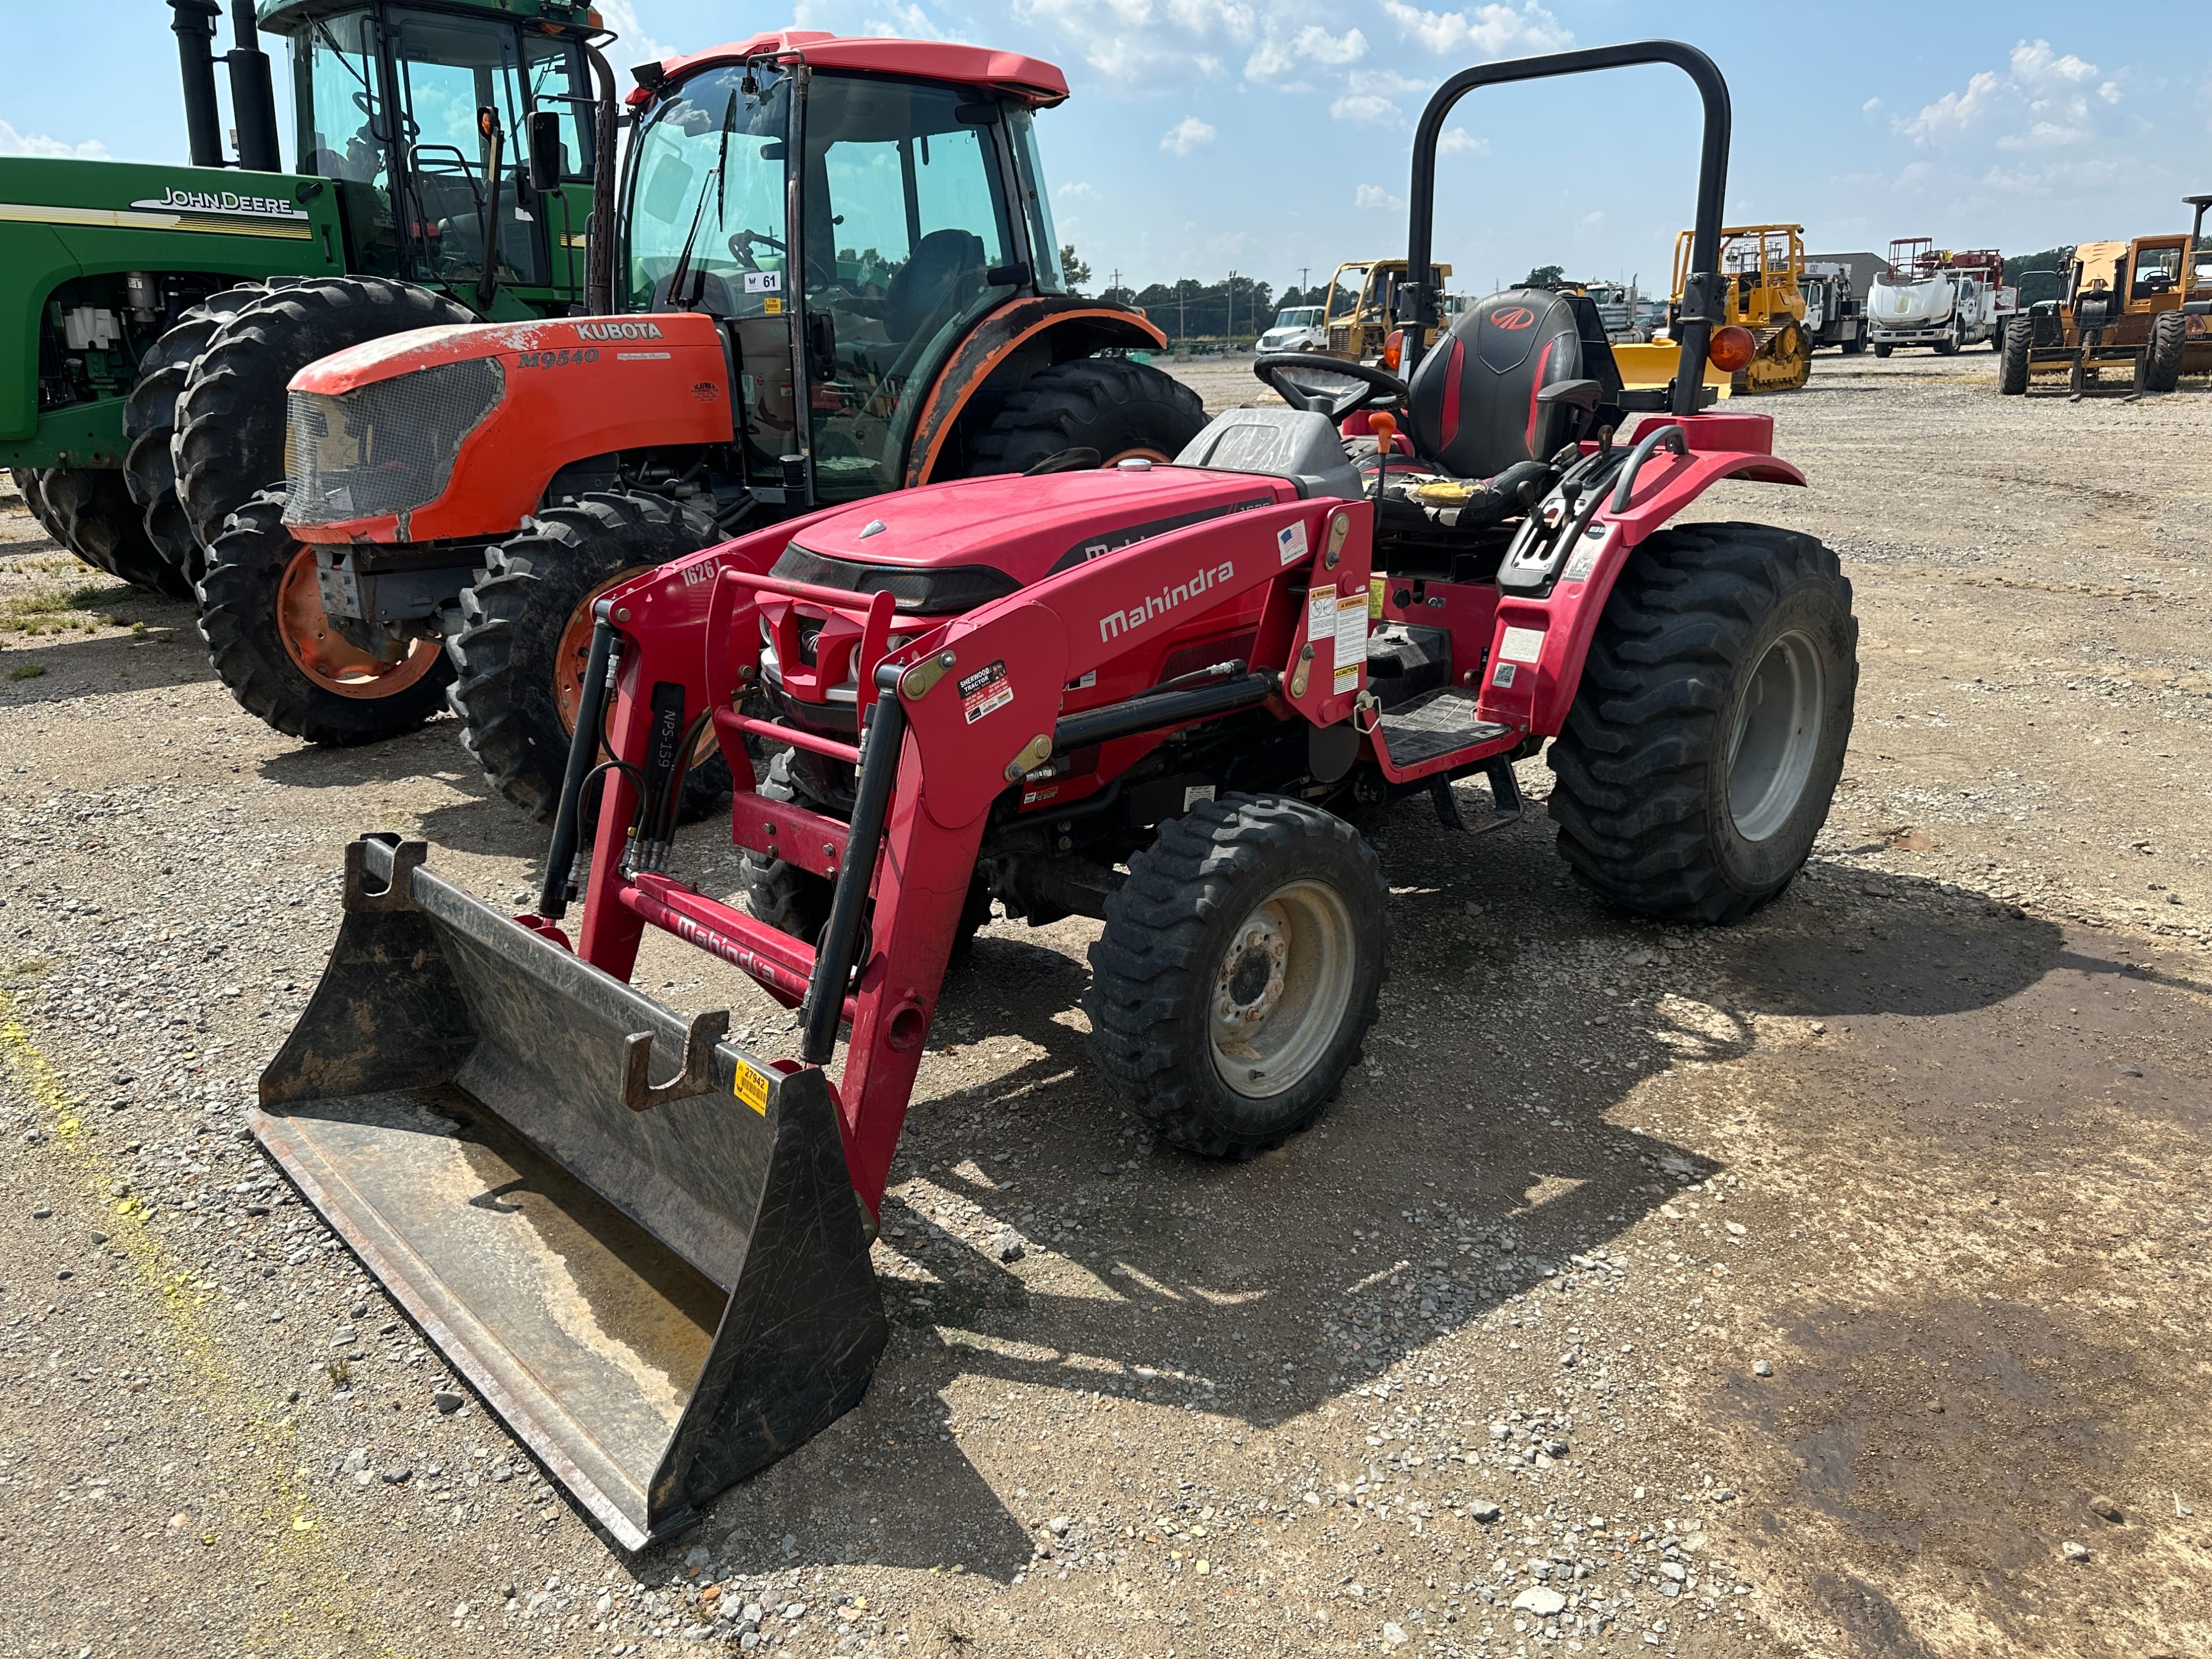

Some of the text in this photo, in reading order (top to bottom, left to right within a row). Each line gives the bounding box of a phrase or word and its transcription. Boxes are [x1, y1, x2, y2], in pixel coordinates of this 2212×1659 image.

[160, 186, 294, 213] JOHN DEERE
[763, 275, 775, 288] 61
[575, 322, 665, 341] KUBOTA
[517, 348, 599, 370] M9540
[681, 560, 715, 587] 1626
[1099, 561, 1234, 643] Mahindra
[1345, 598, 1363, 607] WARNING
[960, 667, 989, 688] SHERWOOD
[1339, 666, 1357, 676] CAUTION
[964, 675, 989, 692] TRACTOR
[658, 709, 676, 768] NPS-159
[677, 915, 776, 984] Mahindra
[745, 1067, 765, 1089] 27942
